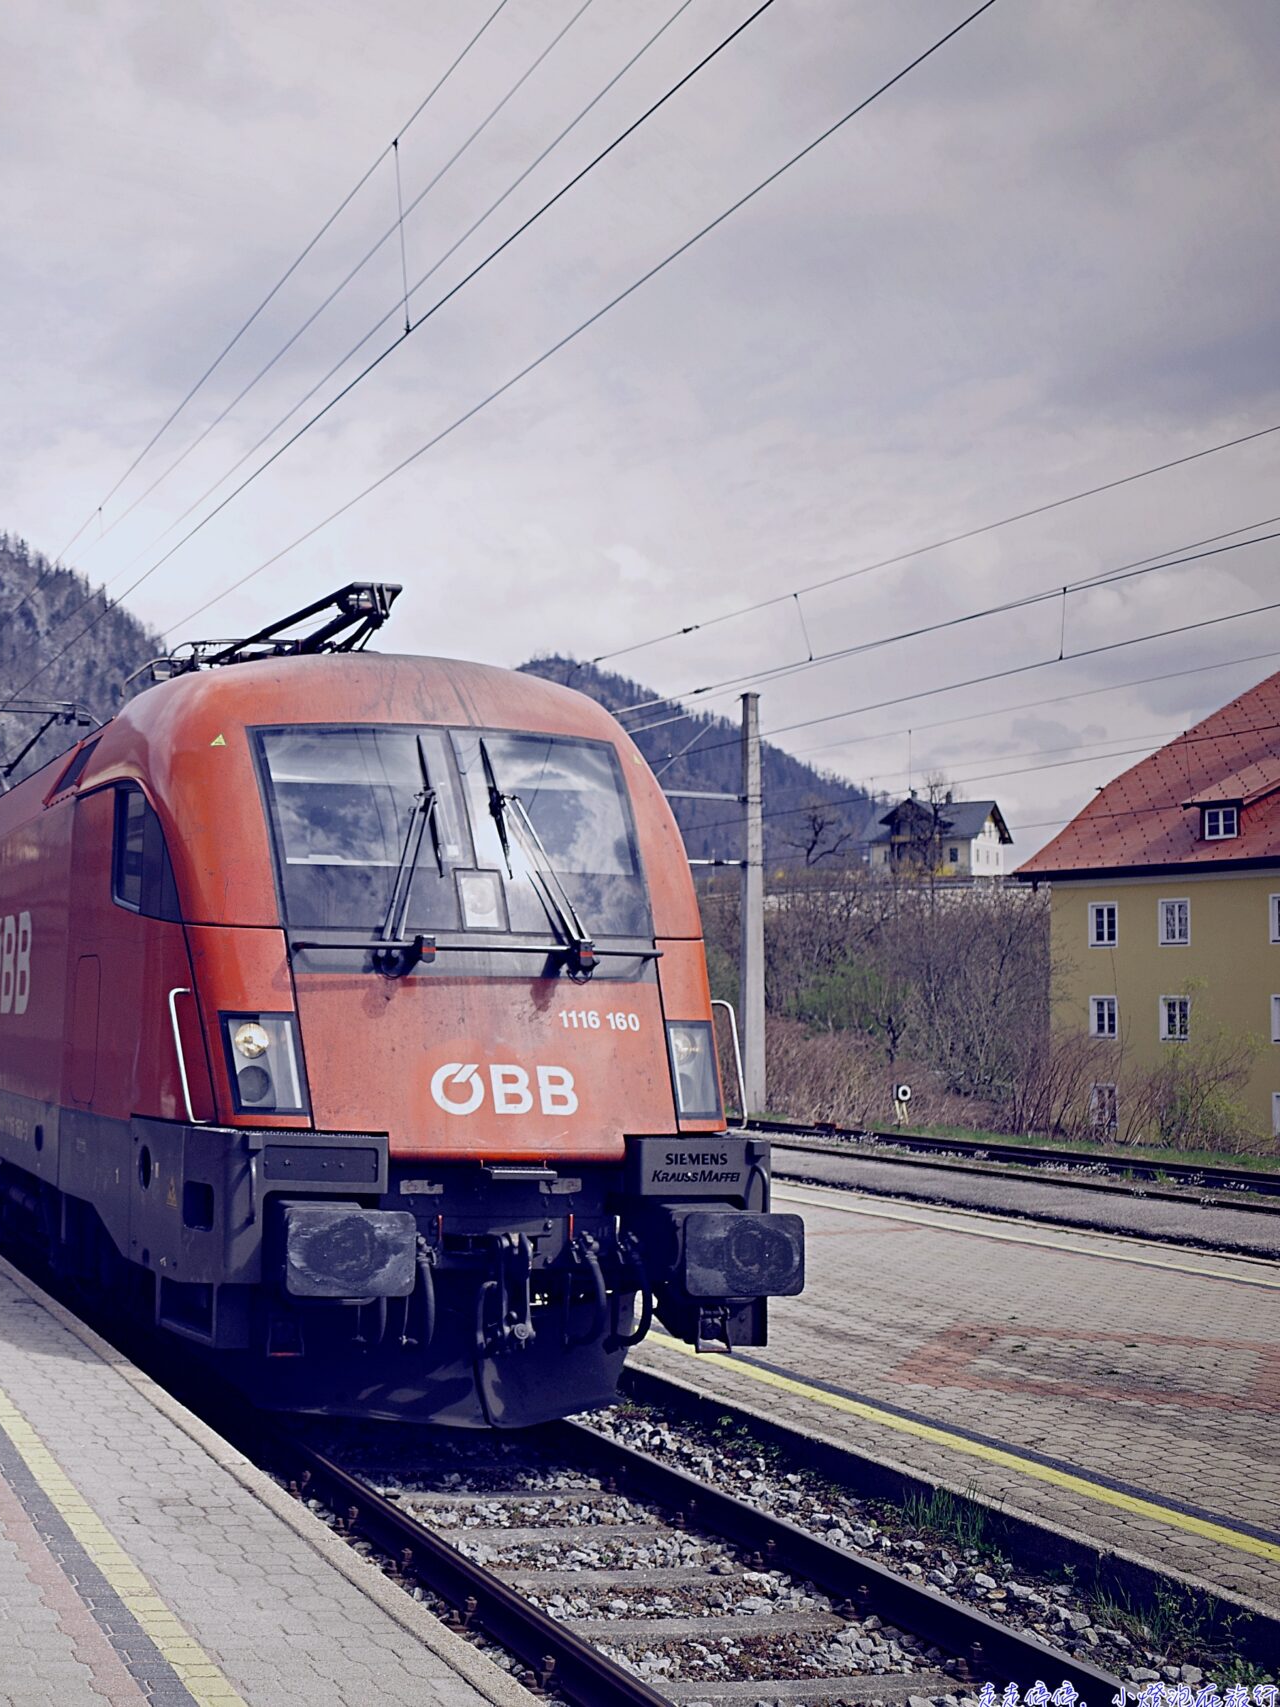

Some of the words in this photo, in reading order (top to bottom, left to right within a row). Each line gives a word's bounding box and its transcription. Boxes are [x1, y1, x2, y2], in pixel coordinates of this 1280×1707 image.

[558, 1010, 601, 1030] 1116
[605, 1012, 641, 1032] 160
[430, 1062, 580, 1116] ÖBB
[665, 1152, 728, 1166] SIEMENS
